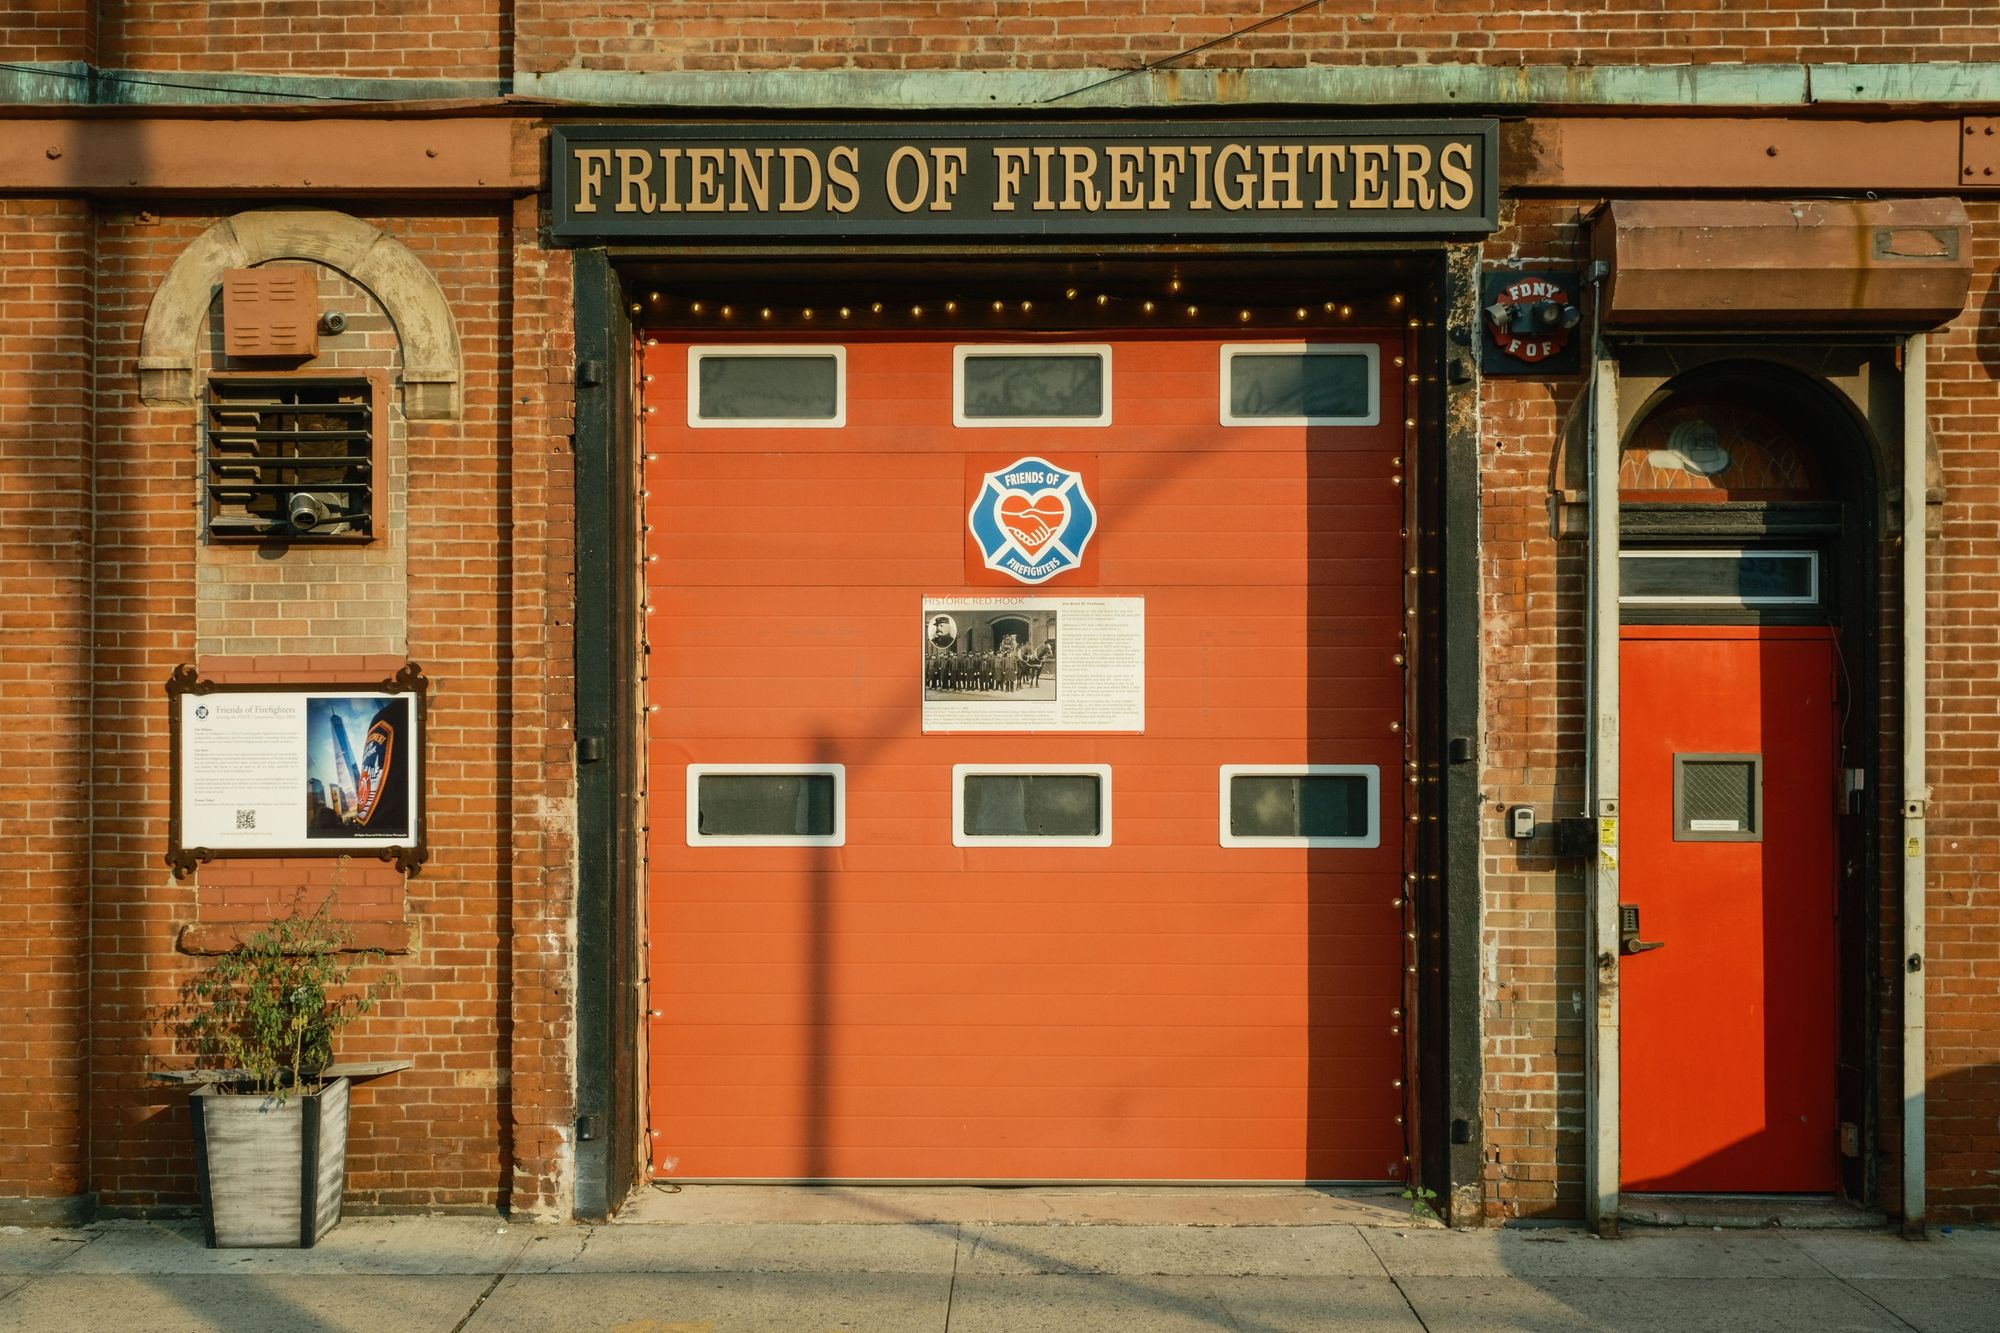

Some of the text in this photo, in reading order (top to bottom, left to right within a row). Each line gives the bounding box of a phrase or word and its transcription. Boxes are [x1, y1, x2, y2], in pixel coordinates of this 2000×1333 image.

[573, 142, 1475, 215] FRIENDS OF FIREFIGHTERS
[1509, 282, 1560, 301] FDNY
[1004, 471, 1060, 487] FRIENDS OF
[1006, 557, 1061, 577] FIREFIGHTERS
[924, 597, 1025, 606] HISTORIC RED HOOK
[216, 705, 296, 715] Friends of Firefighters
